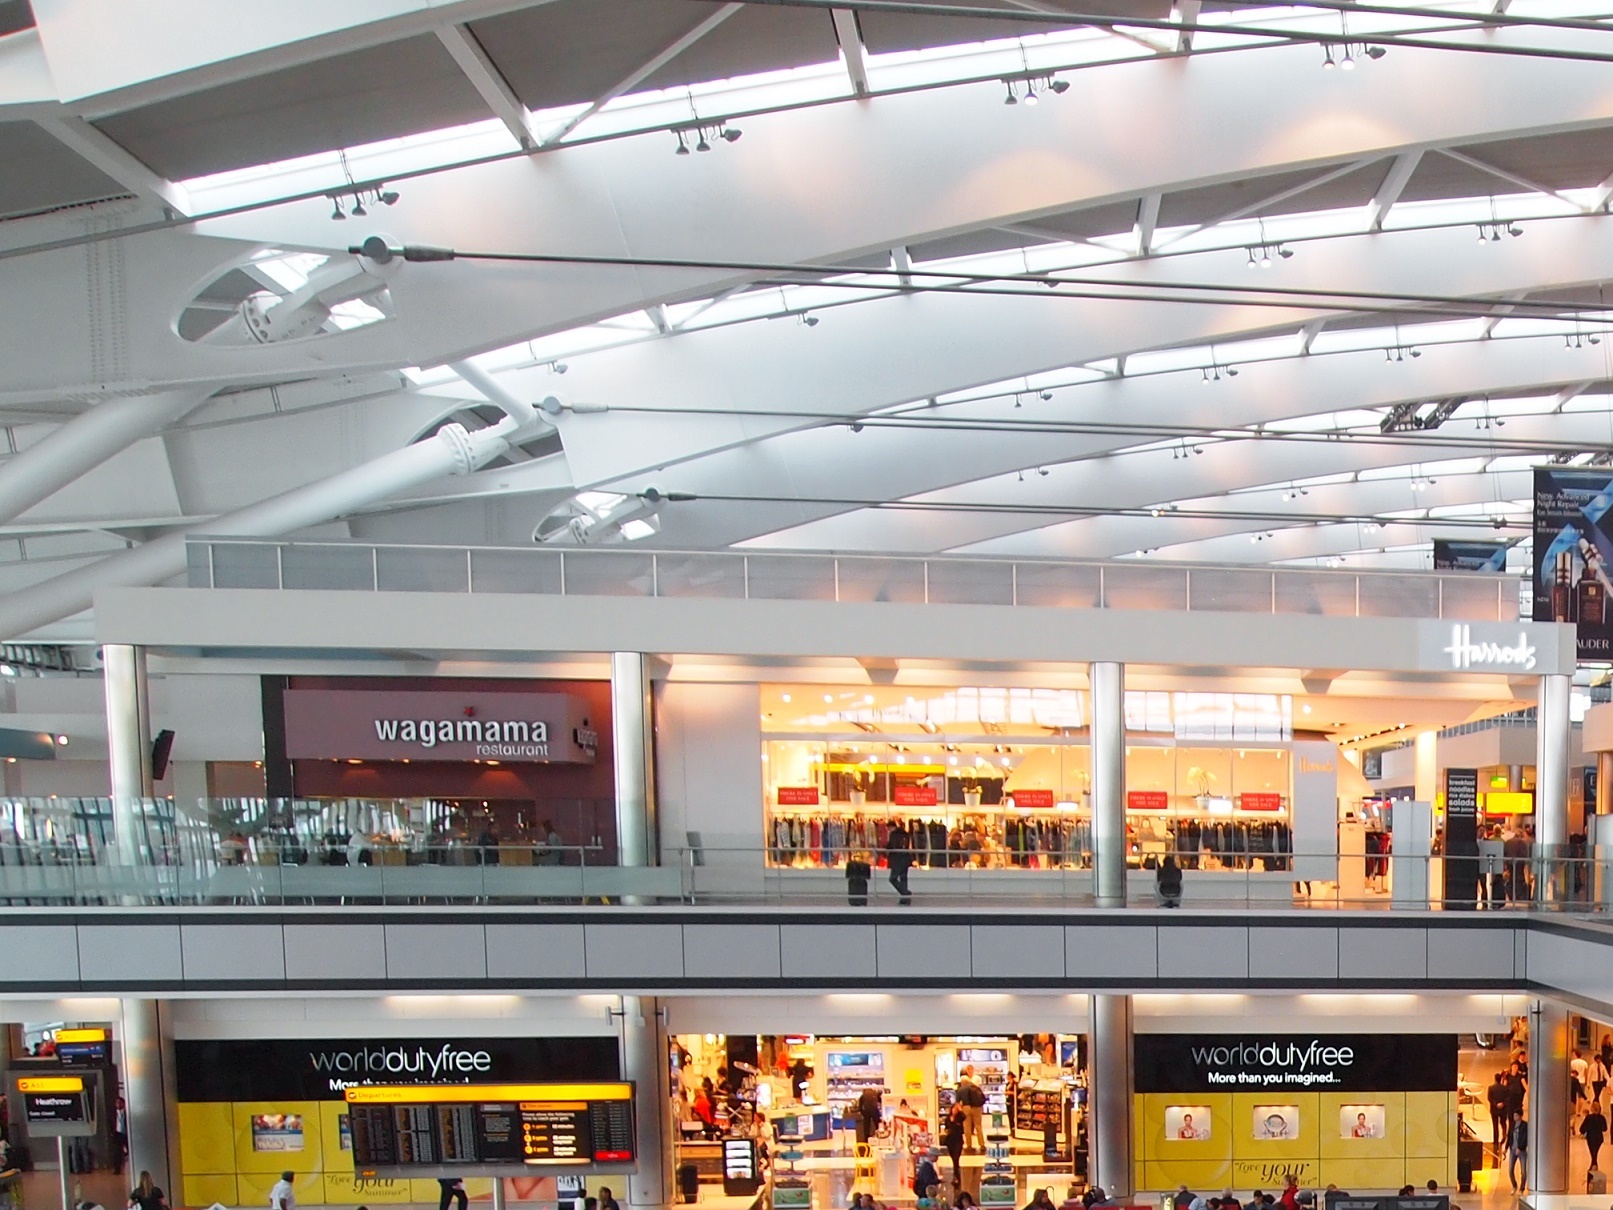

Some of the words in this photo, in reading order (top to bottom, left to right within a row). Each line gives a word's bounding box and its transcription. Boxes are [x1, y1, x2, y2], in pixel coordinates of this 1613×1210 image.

[1556, 491, 1590, 500] Advanced
[1536, 500, 1556, 509] Night
[1557, 500, 1579, 510] Repair
[1443, 624, 1537, 670] Harrods
[374, 719, 548, 748] wagamama
[476, 743, 549, 757] restaurant
[309, 1043, 492, 1079] worlddutyfree
[1191, 1040, 1354, 1073] worlddutyfree
[1208, 1072, 1237, 1084] More
[1237, 1072, 1262, 1084] than
[1263, 1074, 1283, 1087] you
[1284, 1071, 1342, 1087] imagined...
[35, 1098, 73, 1106] Heathrow
[358, 1092, 402, 1100] Departures
[1261, 1163, 1310, 1183] your
